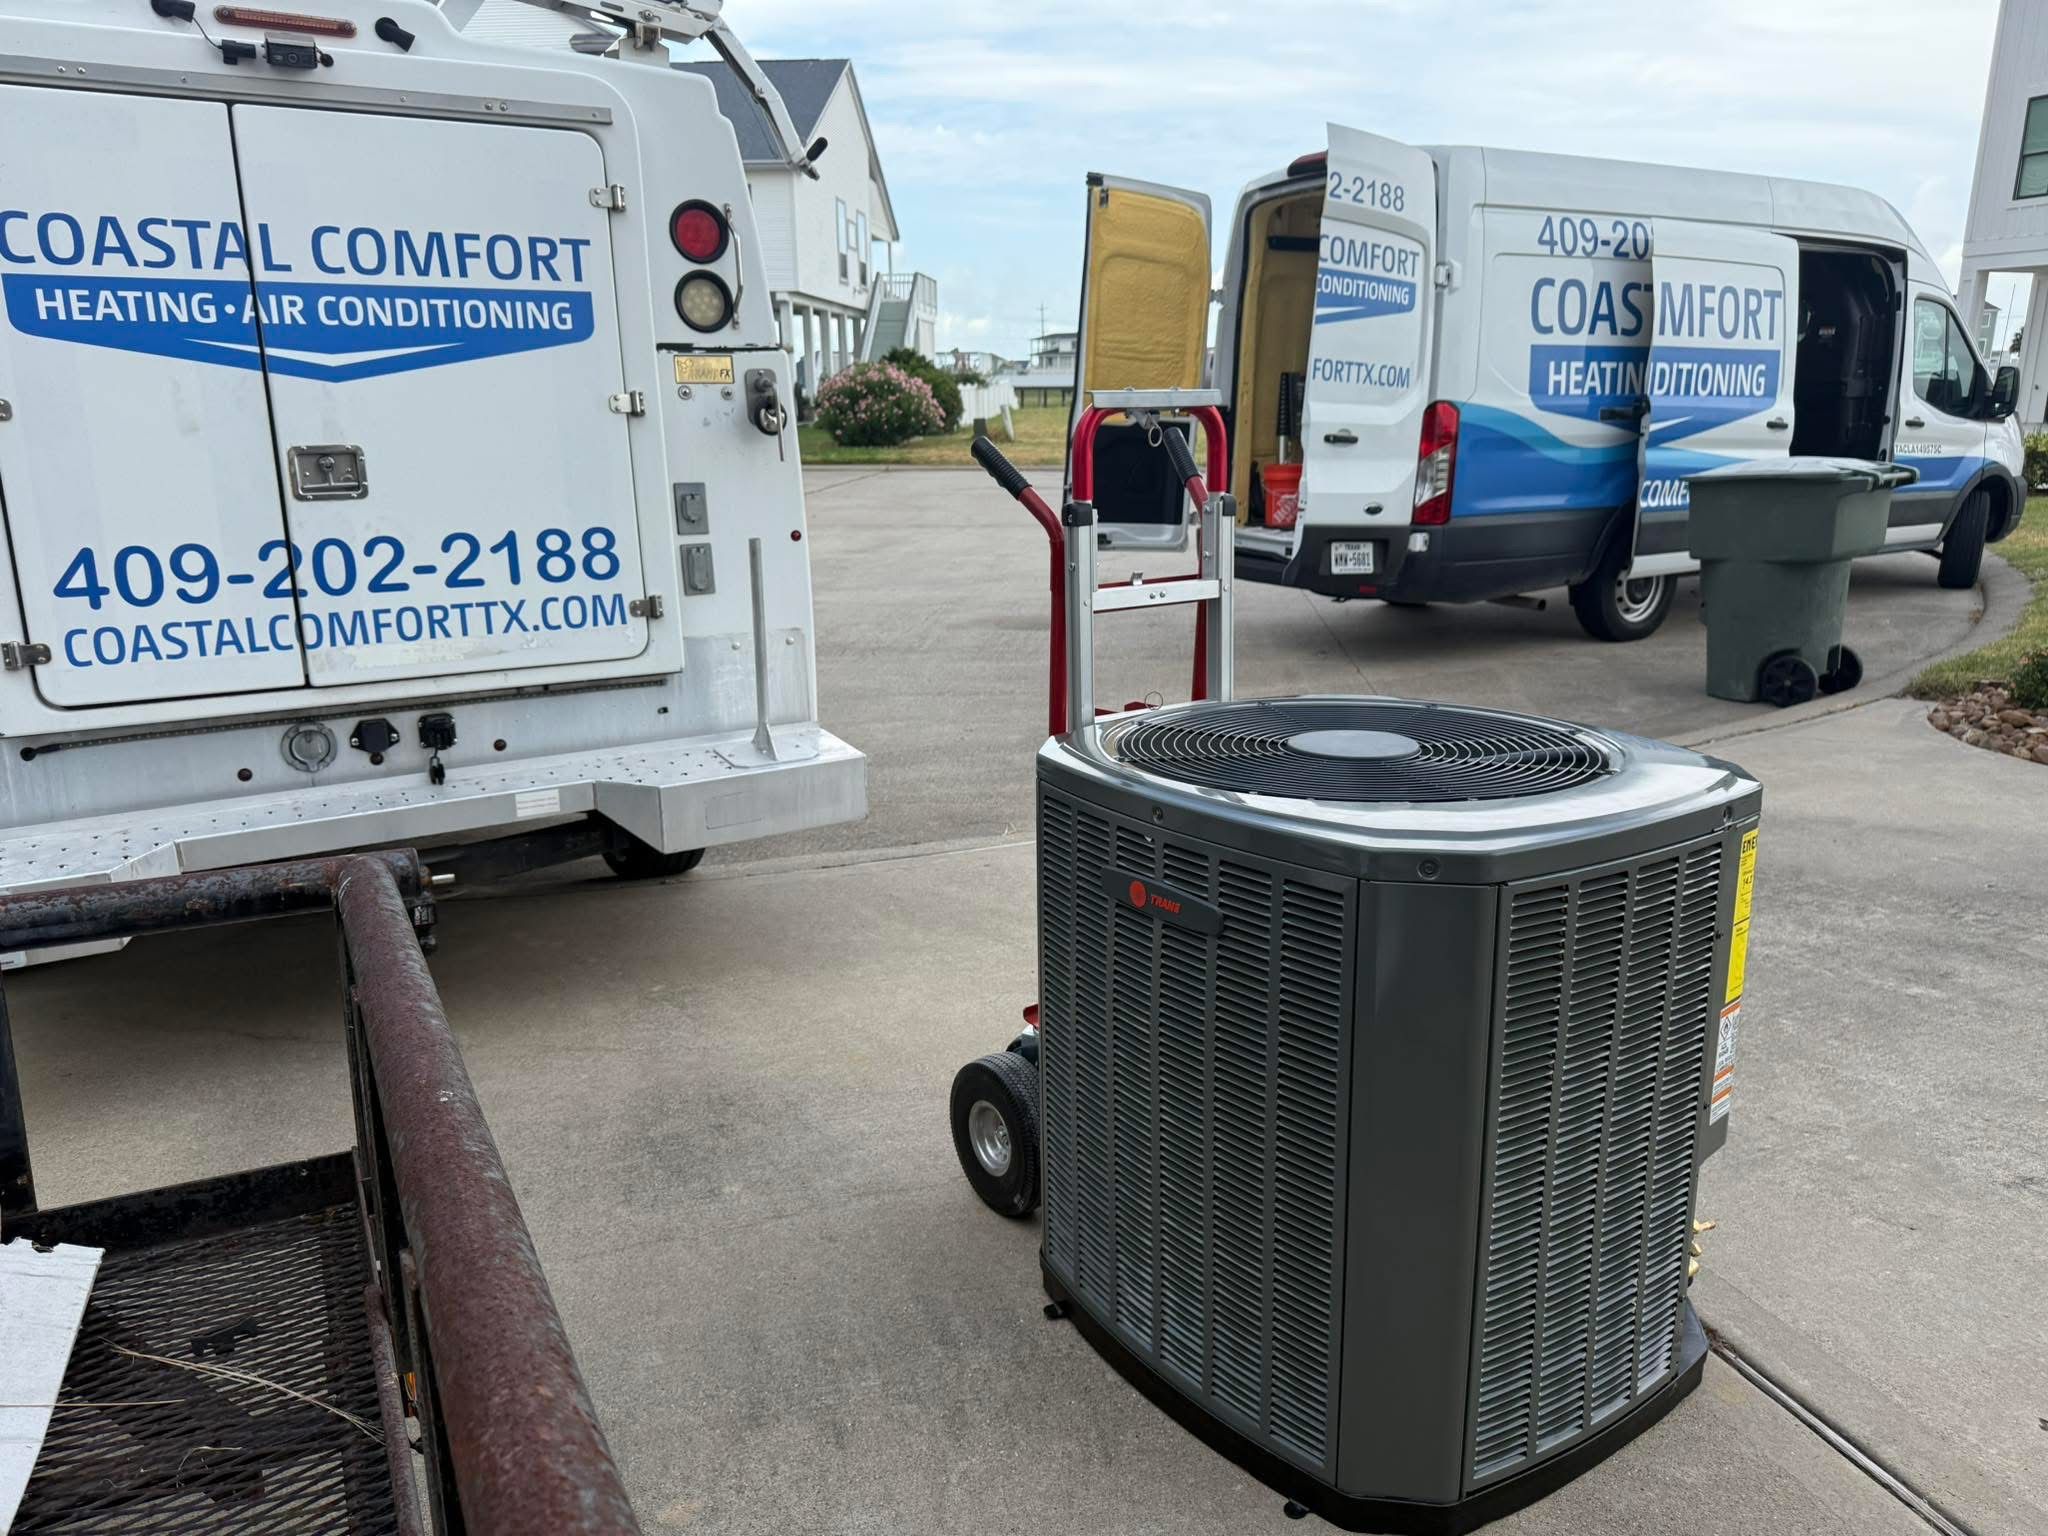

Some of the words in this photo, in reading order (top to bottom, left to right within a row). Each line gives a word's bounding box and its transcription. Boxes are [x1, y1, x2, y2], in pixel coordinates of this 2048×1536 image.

[1329, 171, 1404, 212] 2-2188
[0, 210, 292, 272] COASTAL
[310, 225, 591, 283] COMFORT
[1319, 235, 1419, 278] COMFORT
[1537, 215, 1654, 260] 409-20
[35, 288, 218, 325] HEATING
[242, 294, 307, 325] AIR
[317, 295, 573, 331] CONDITIONING
[1312, 358, 1411, 390] FORTTX.COM
[53, 527, 621, 610] 409-202-2188
[63, 592, 629, 668] COASTALCOMFORTTX.COM
[1151, 894, 1180, 913] TRANE
